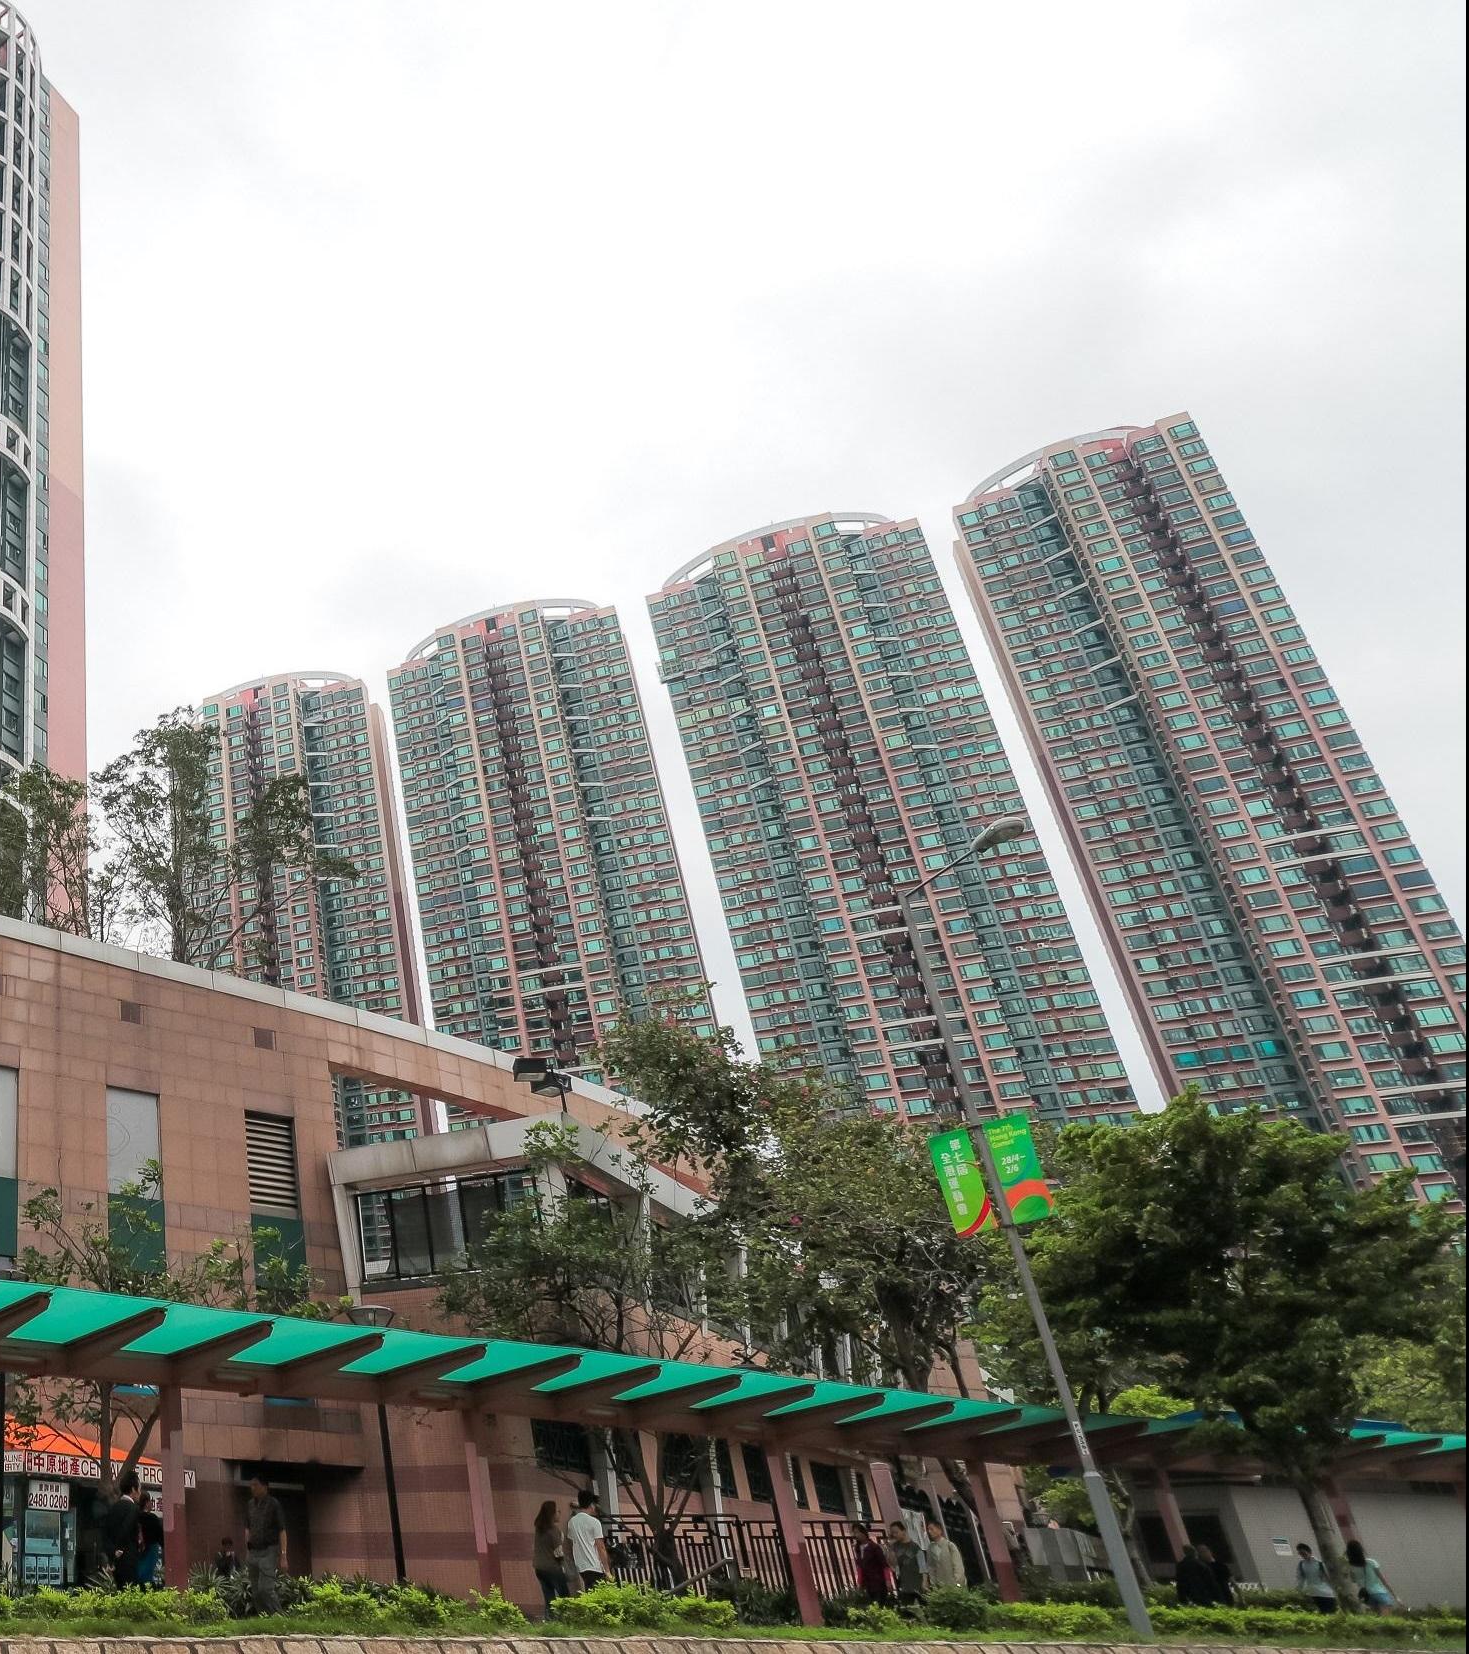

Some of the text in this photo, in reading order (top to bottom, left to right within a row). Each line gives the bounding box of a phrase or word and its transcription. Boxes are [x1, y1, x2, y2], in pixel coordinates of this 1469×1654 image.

[1005, 1164, 1019, 1174] 2/6
[33, 1453, 80, 1475] 中原地產
[28, 1492, 68, 1509] 2480 0208
